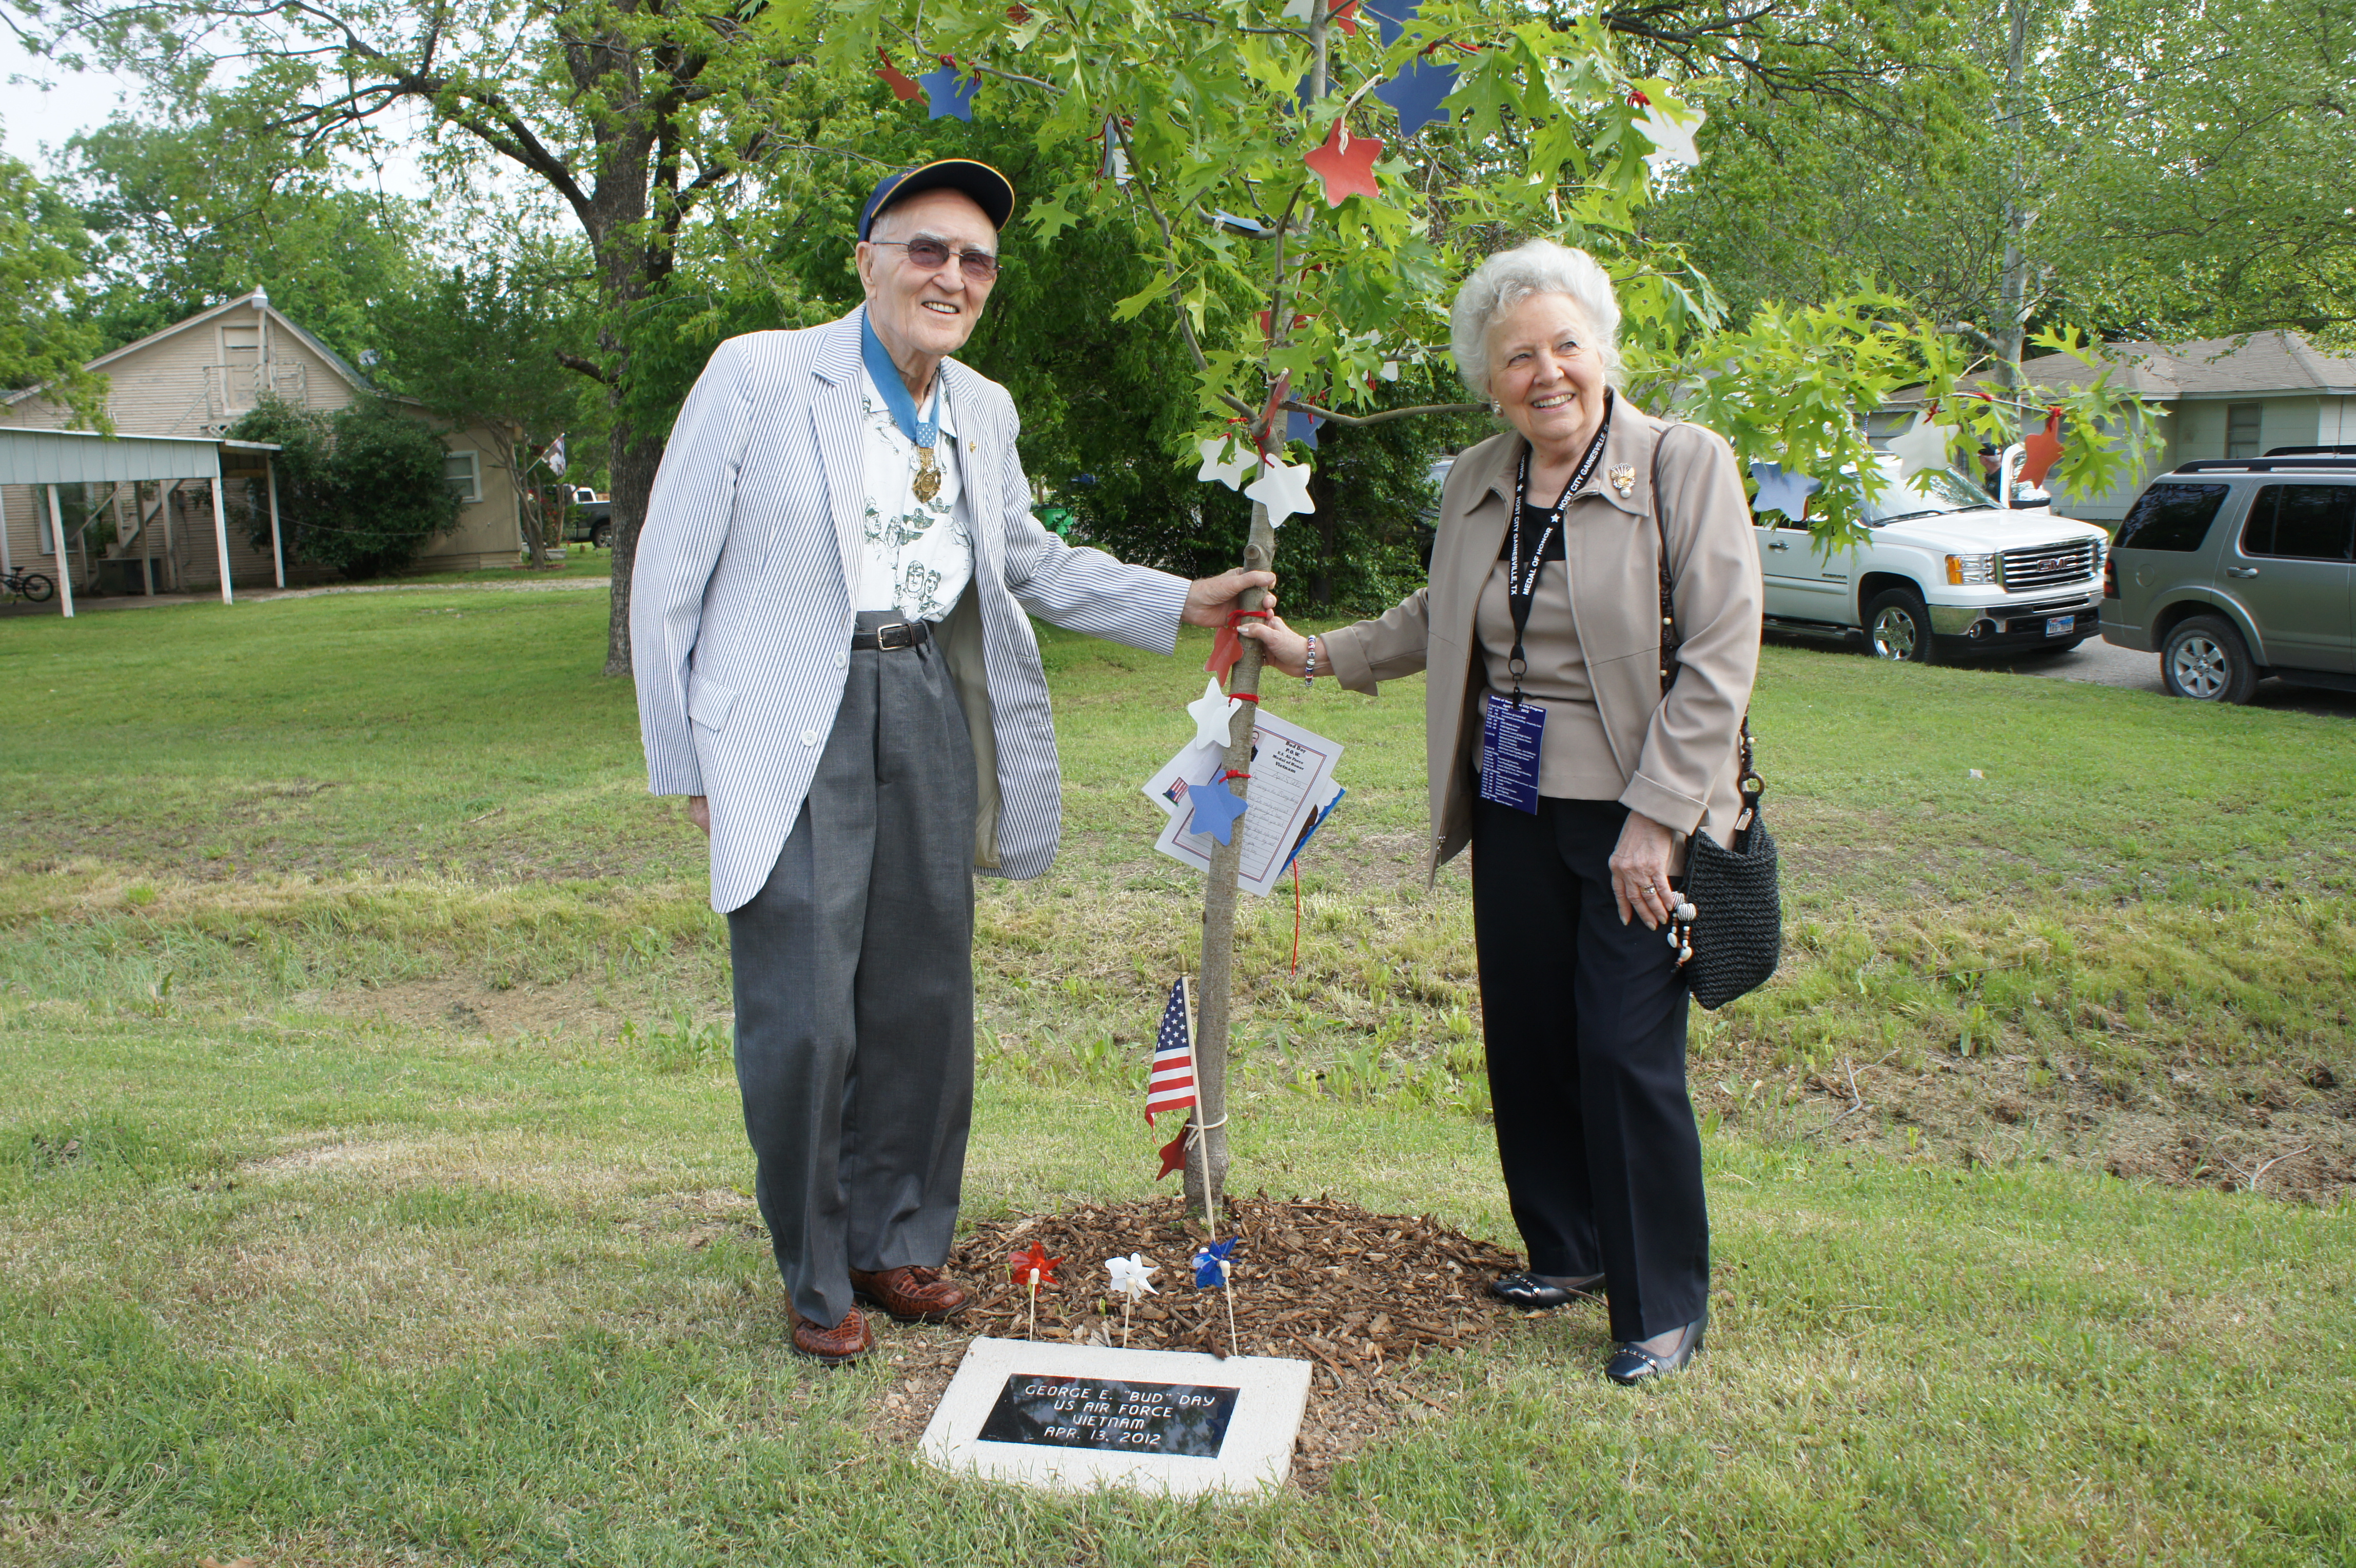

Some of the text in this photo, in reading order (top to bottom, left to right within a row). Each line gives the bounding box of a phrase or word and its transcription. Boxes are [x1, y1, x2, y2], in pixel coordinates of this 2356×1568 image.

[1558, 490, 1573, 511] HOST
[1570, 474, 1583, 492] CITY
[1522, 527, 1553, 595] MEDAL OF HONOR
[2037, 555, 2078, 573] GMC
[1511, 584, 1517, 595] TX
[1285, 748, 1301, 757] P.O.W.
[1272, 754, 1286, 762] Medal
[1290, 762, 1304, 770] Honor
[1275, 761, 1296, 773] Vietnam
[1025, 1385, 1215, 1406] GEORGE E. "BUD" DAY
[1054, 1400, 1173, 1418] US AIR FORCE
[1073, 1414, 1145, 1429] VIETNAM
[1044, 1426, 1080, 1439] APR.
[1120, 1432, 1161, 1445] 2012
